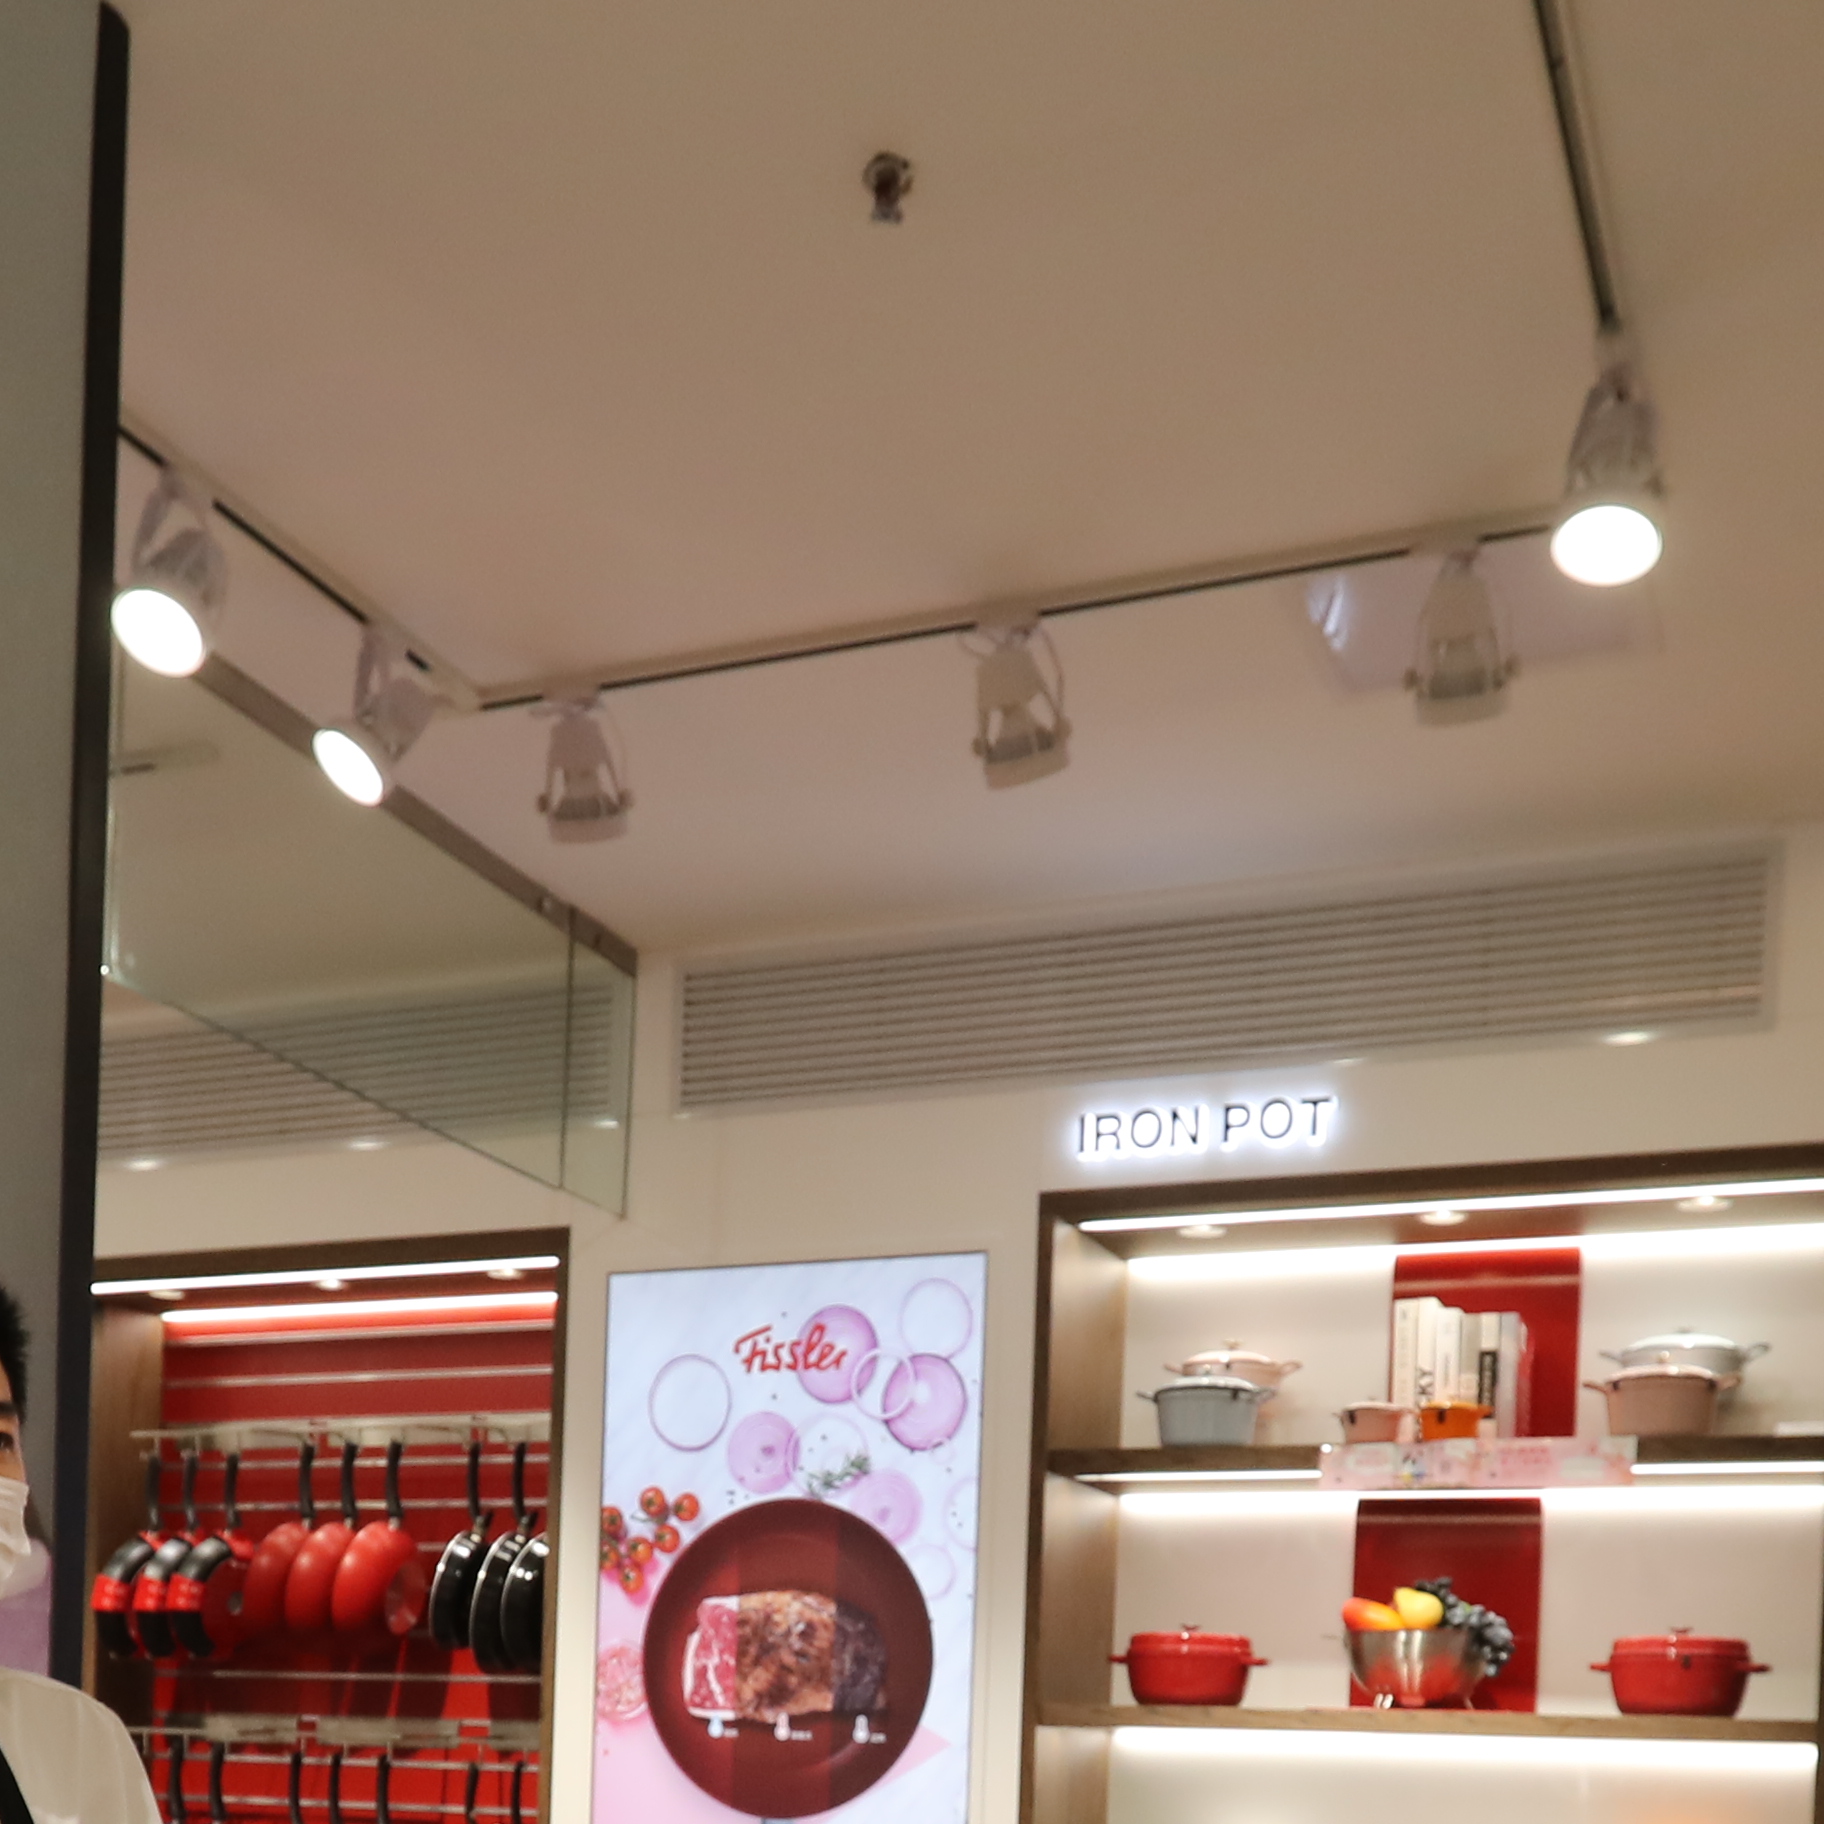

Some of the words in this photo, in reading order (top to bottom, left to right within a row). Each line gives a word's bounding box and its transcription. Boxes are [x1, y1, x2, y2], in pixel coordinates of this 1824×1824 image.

[1078, 1104, 1202, 1155] IRON
[1222, 1095, 1334, 1146] POT
[732, 1322, 847, 1375] Fissler
